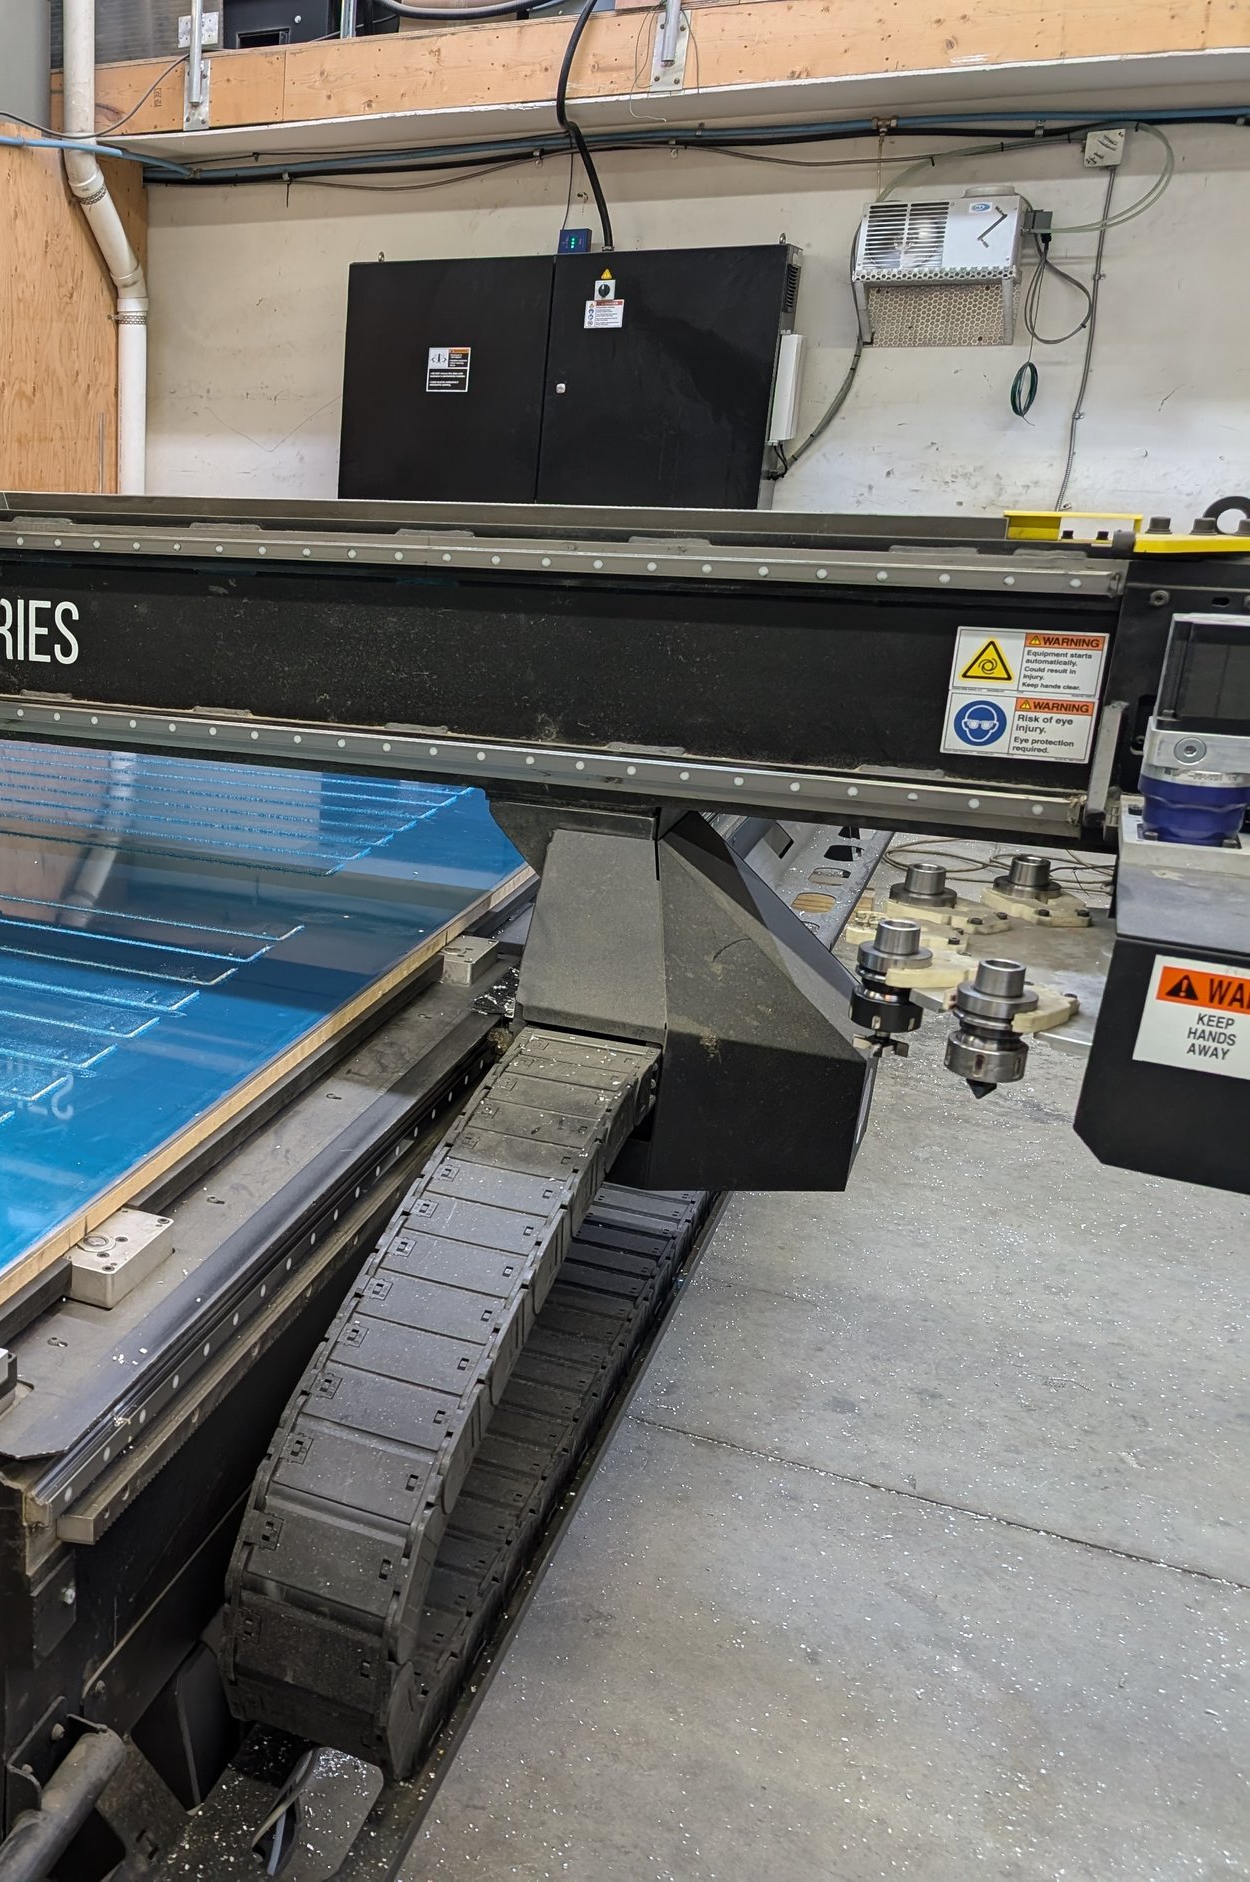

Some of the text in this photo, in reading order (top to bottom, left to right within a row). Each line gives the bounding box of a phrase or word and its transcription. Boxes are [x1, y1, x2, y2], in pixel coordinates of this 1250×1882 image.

[1043, 636, 1100, 648] WARNING
[1026, 650, 1093, 660] Equipment starts
[1025, 658, 1078, 667] automatically.
[1047, 667, 1067, 675] result
[1021, 681, 1081, 691] Keep hands clear.
[1033, 701, 1089, 713] WARNING
[1017, 713, 1074, 726] Risk of eye
[1015, 724, 1047, 735] injury.
[1013, 736, 1074, 748] Eye protection
[1012, 746, 1050, 754] required.
[1196, 1012, 1235, 1030] KEEP
[1187, 1026, 1237, 1047] HANDS
[1186, 1042, 1230, 1060] AWAY
